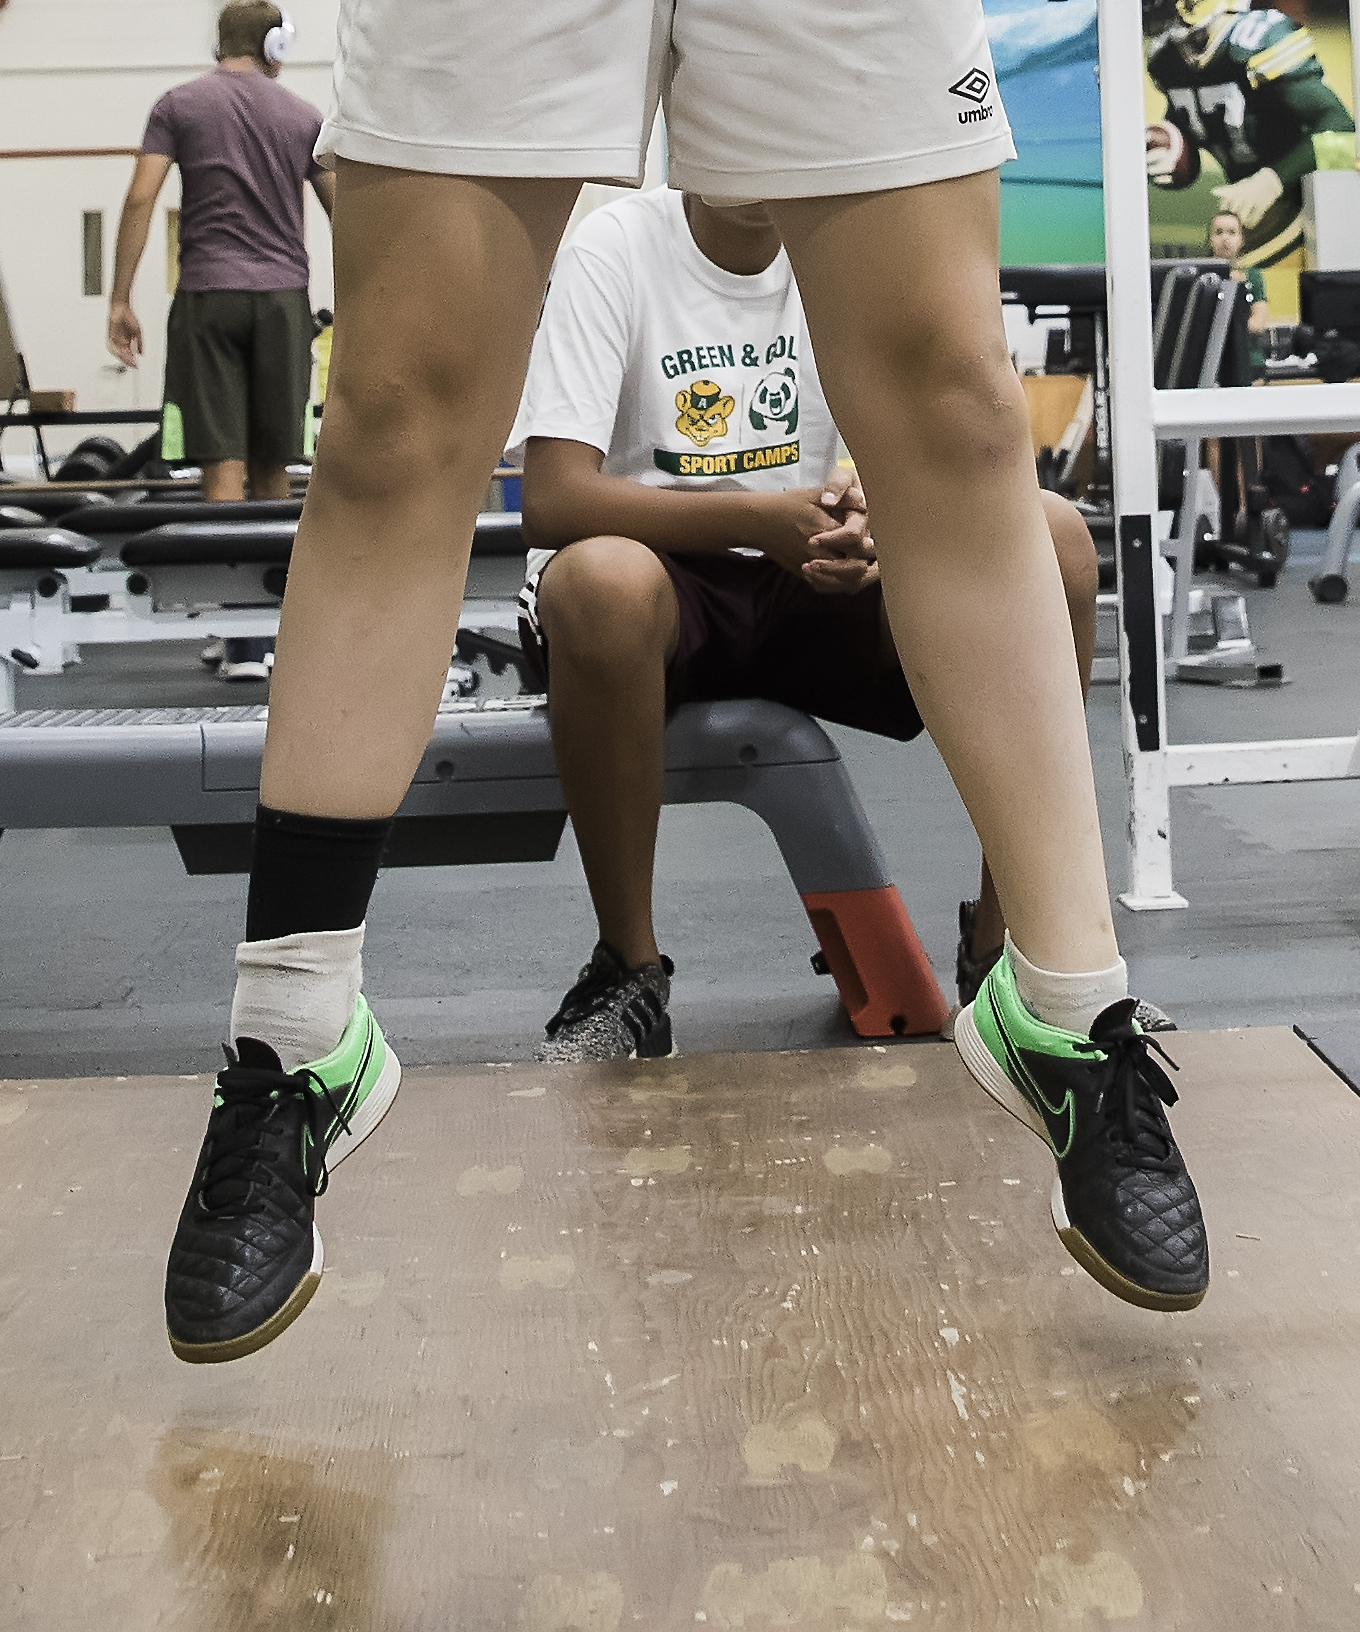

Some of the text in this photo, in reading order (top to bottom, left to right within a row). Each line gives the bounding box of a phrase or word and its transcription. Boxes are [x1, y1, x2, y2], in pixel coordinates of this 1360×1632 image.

[660, 335, 799, 380] GREEN & GOL
[679, 443, 799, 475] SPORT CAMPS
